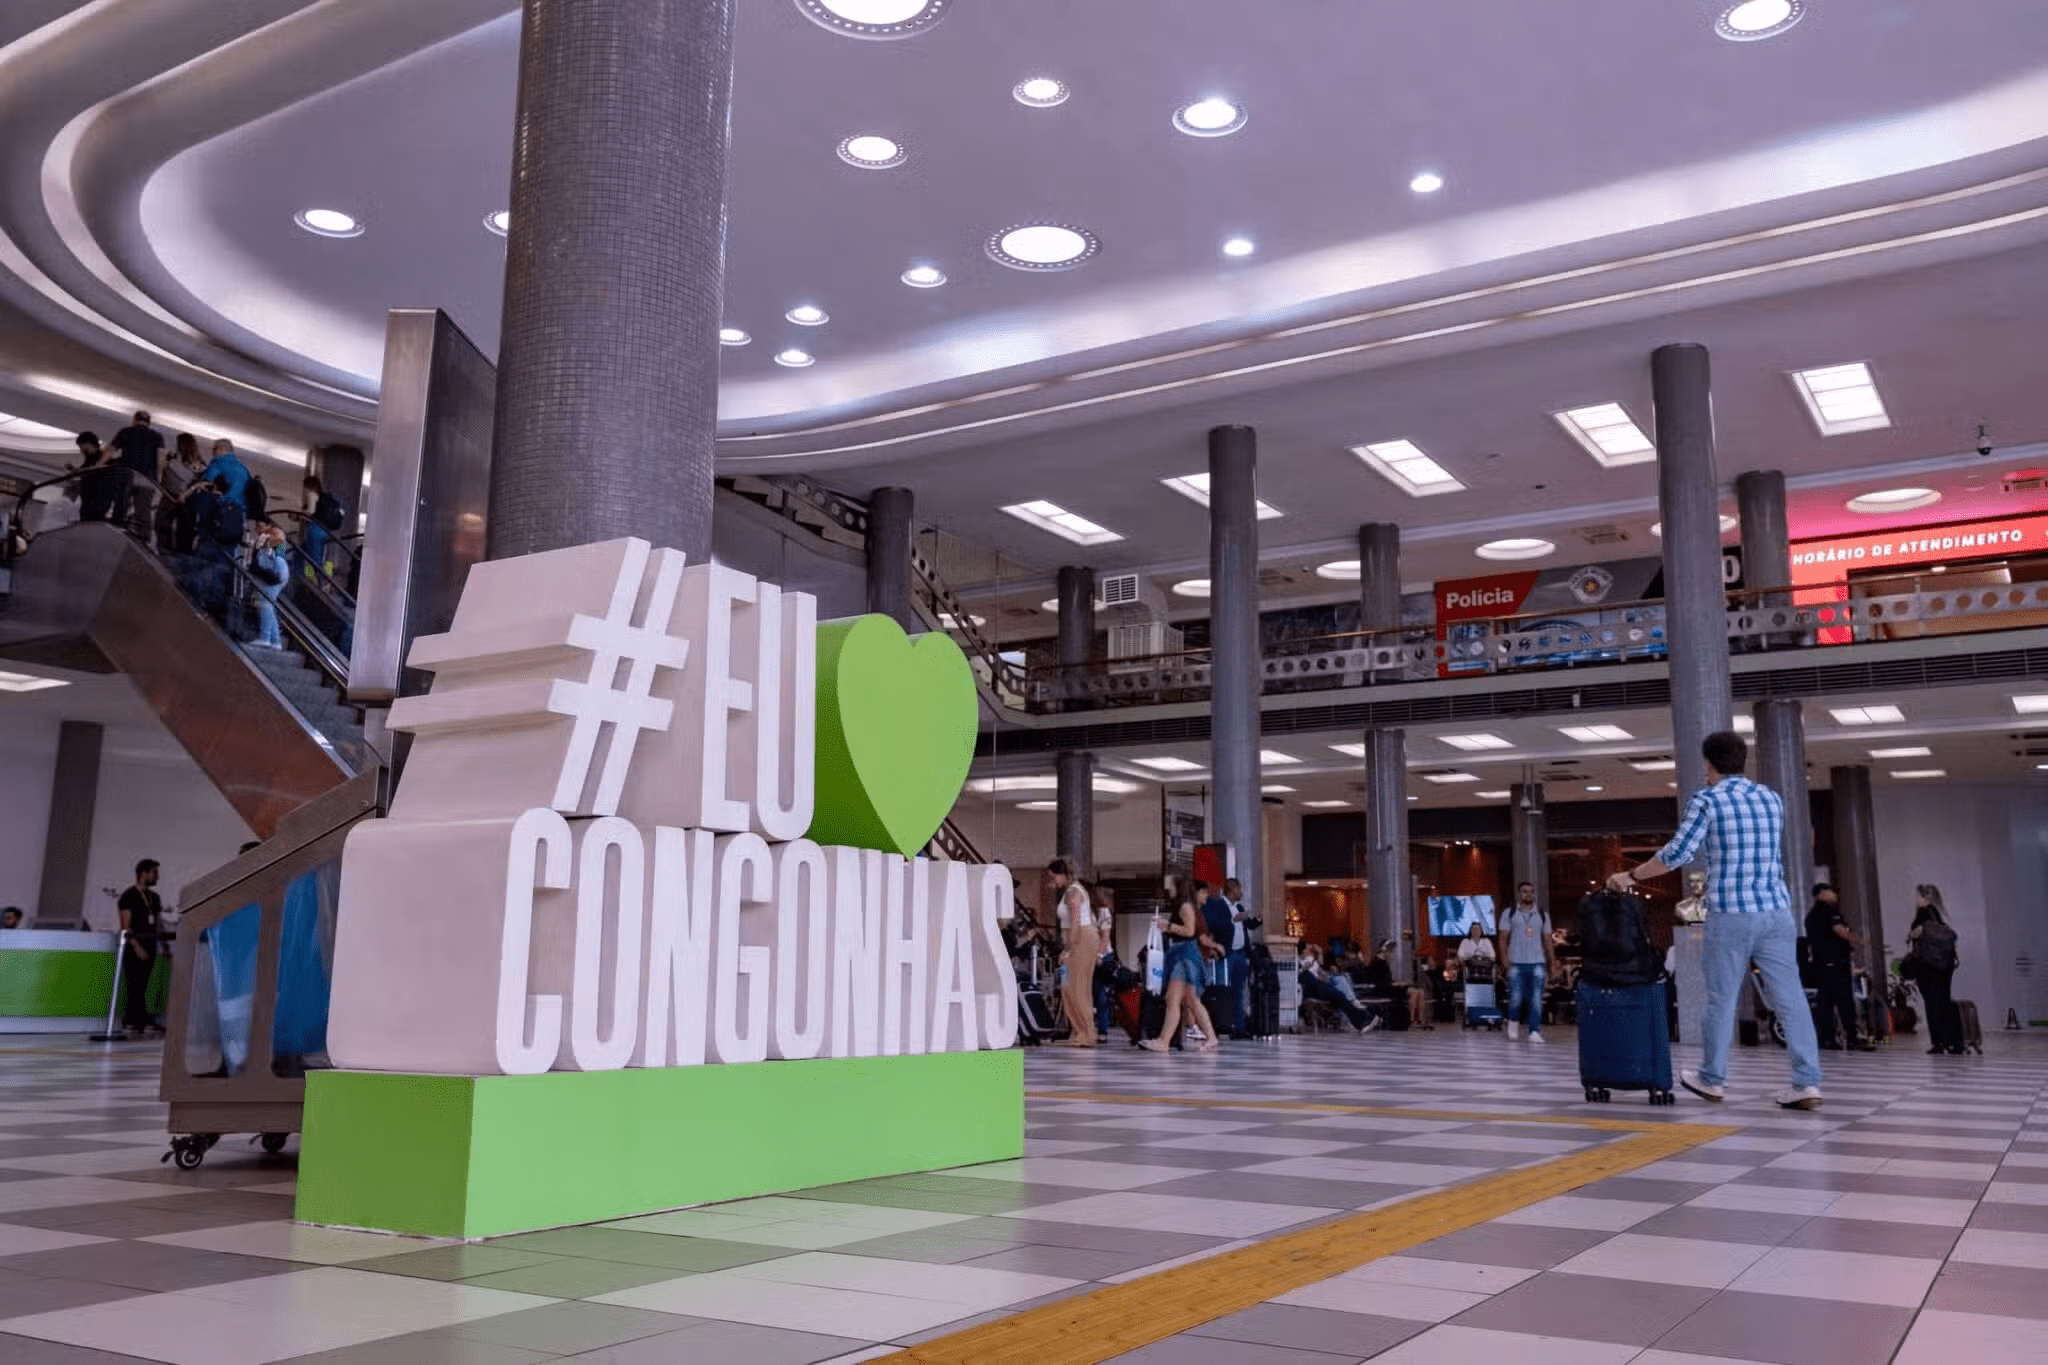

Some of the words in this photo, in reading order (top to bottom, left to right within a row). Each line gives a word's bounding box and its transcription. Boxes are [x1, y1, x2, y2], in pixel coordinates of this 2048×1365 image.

[1445, 586, 1515, 610] Polícia
[1792, 545, 1866, 566] HORÁRIO
[1871, 543, 1893, 557] DE
[1898, 529, 2023, 554] ATENDIMENTO
[547, 536, 817, 842] #EU
[495, 806, 1018, 1076] CONGONHAS
